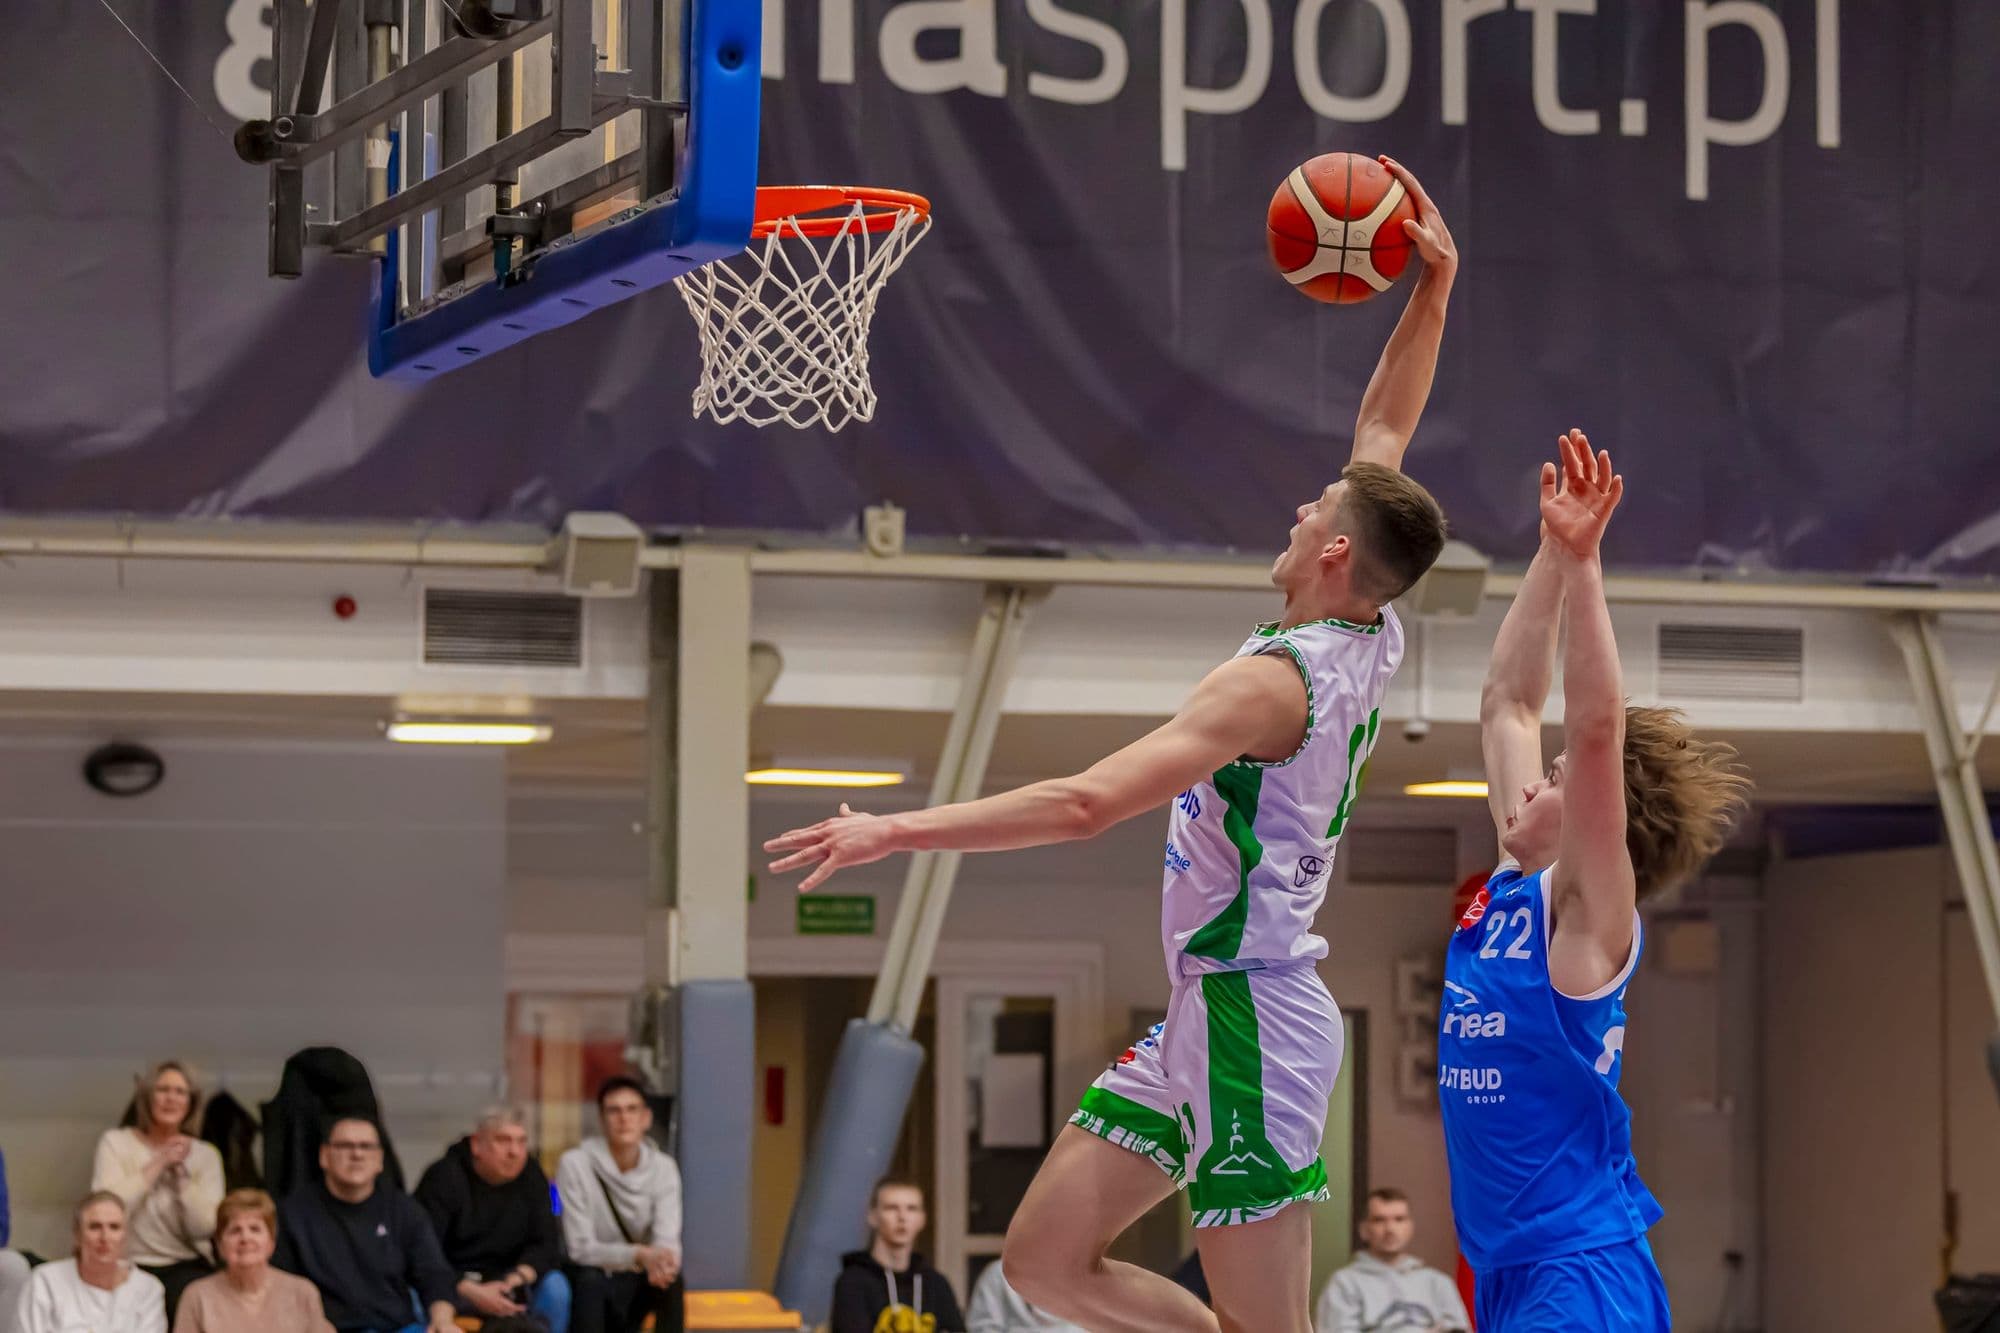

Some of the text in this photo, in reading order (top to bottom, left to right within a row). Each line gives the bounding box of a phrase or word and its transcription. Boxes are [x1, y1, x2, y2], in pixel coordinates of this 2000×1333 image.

[1480, 907, 1532, 959] 22
[1443, 1011, 1506, 1038] nea
[1467, 1095, 1506, 1104] GROUP
